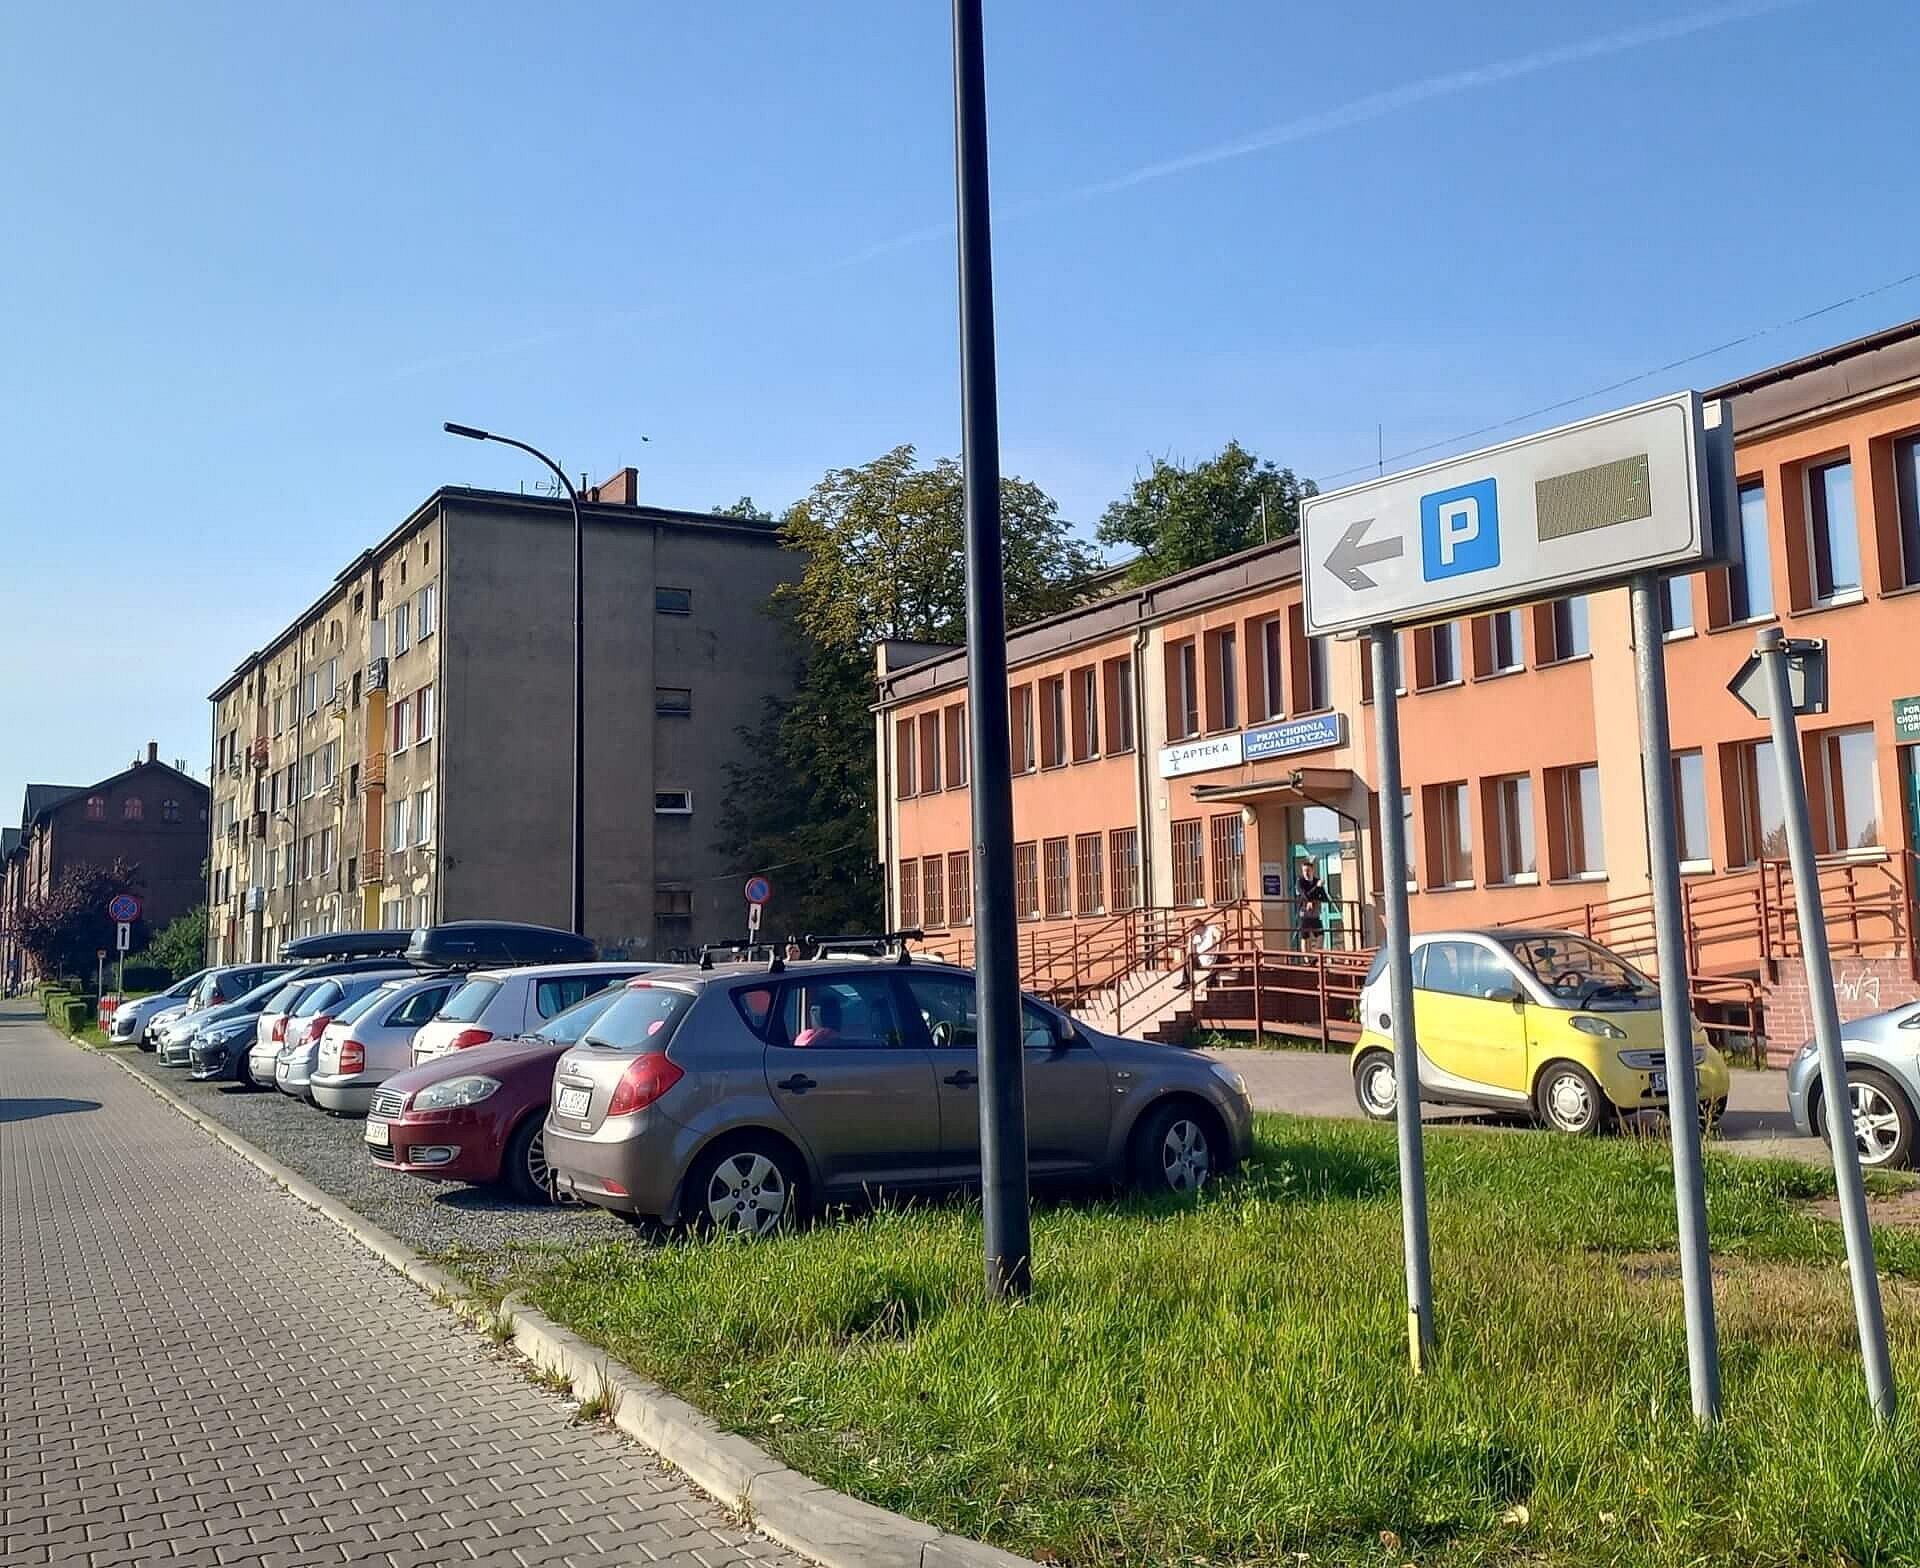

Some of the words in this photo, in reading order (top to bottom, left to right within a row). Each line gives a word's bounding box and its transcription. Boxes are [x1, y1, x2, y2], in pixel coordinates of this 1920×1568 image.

[1439, 496, 1479, 566] P
[1896, 713, 1920, 725] CHOR
[1908, 722, 1920, 732] OR
[1247, 729, 1335, 753] SPECJALISTYCZNA
[1256, 721, 1325, 743] PRZYCHODNIA
[1183, 743, 1230, 760] APTEKA
